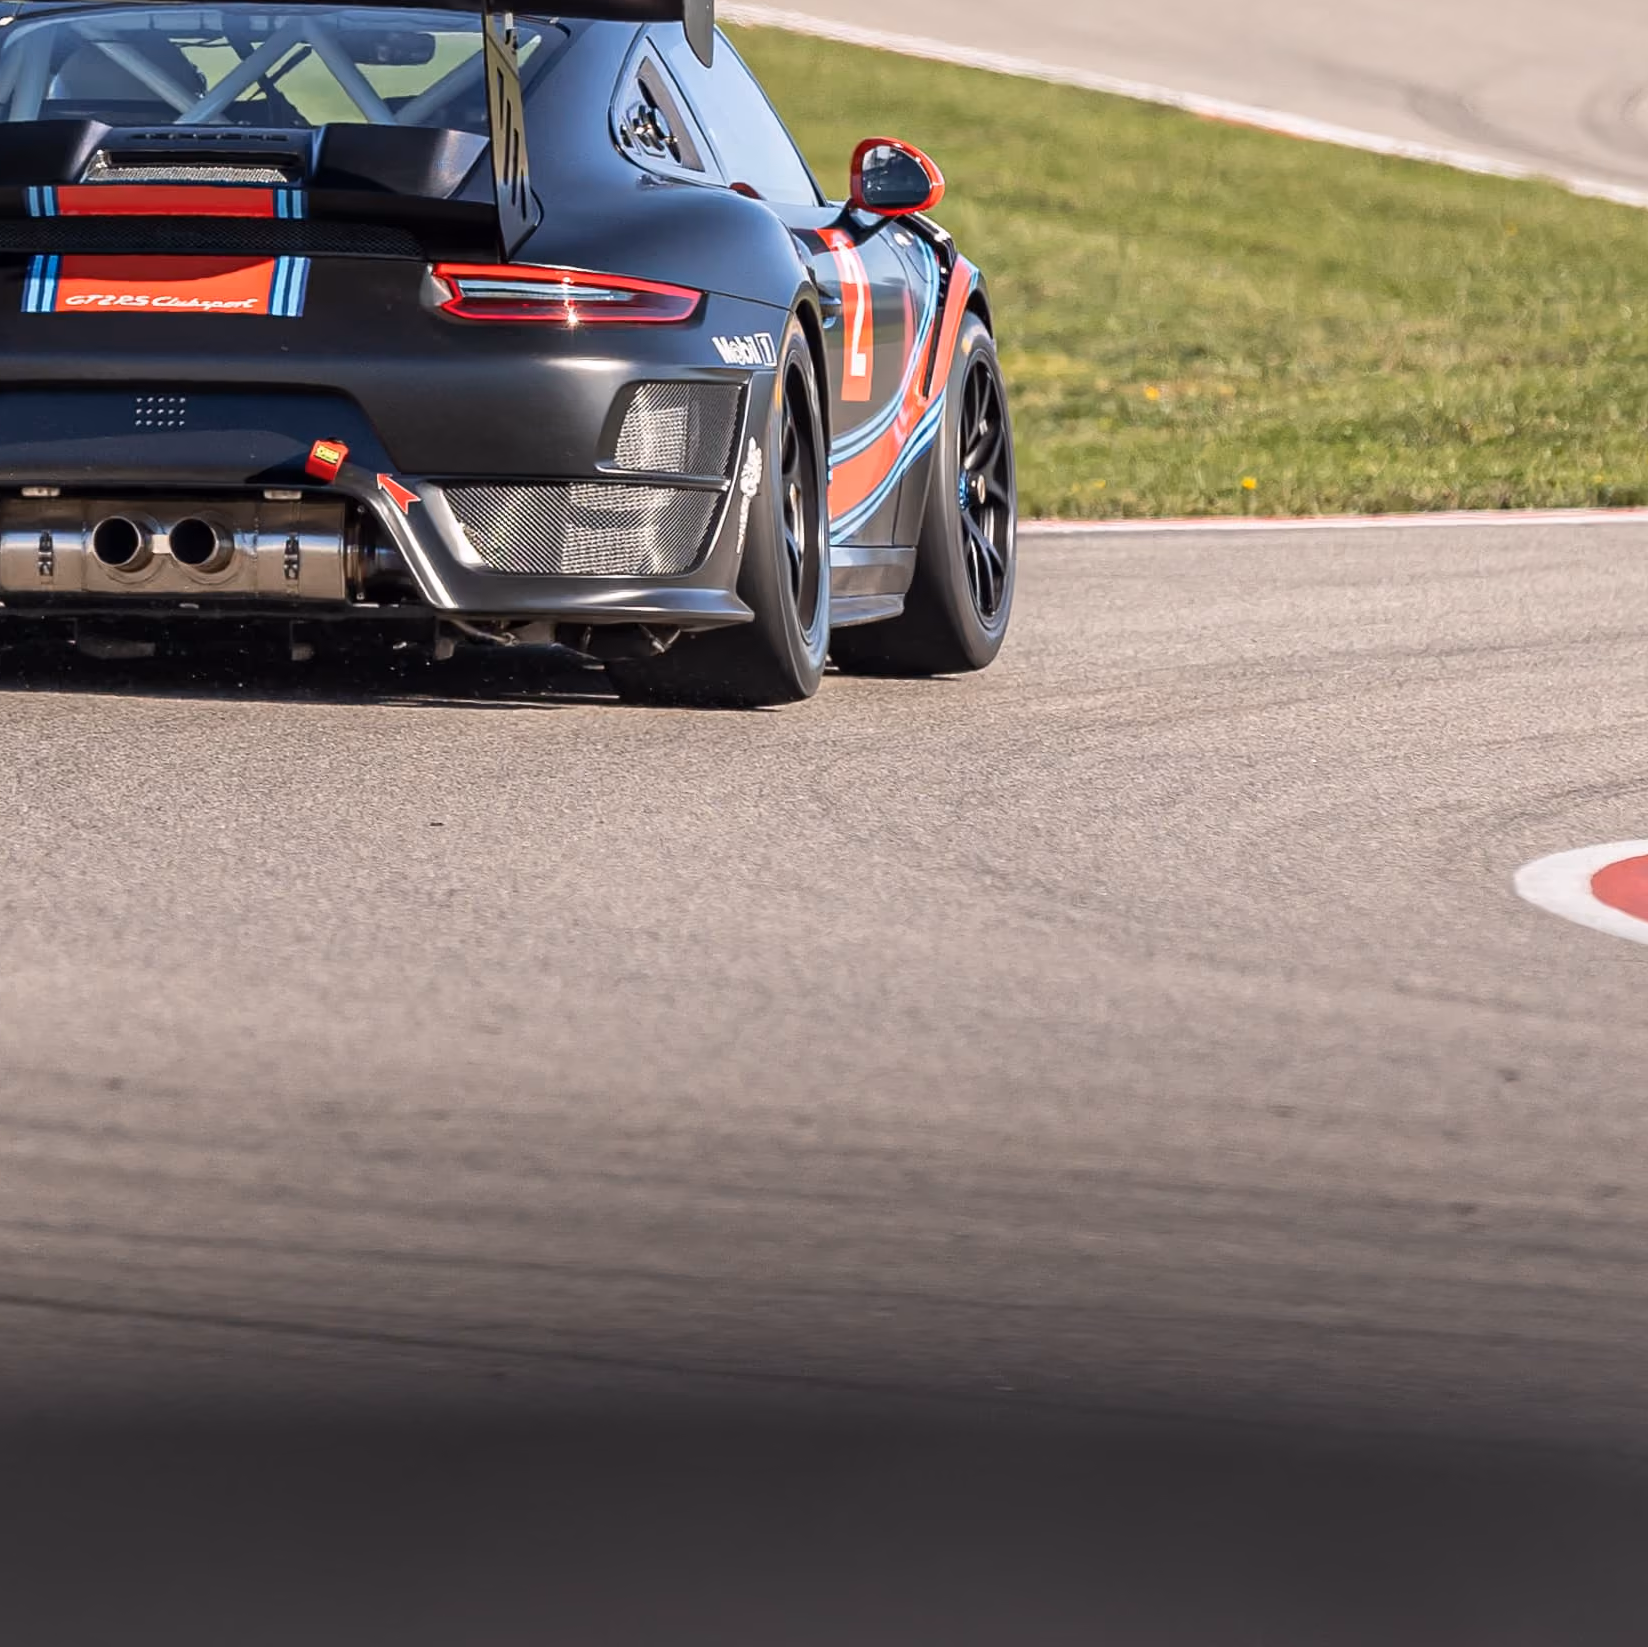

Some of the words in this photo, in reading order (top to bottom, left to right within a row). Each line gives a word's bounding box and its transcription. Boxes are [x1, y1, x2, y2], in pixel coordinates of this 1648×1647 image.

[152, 296, 258, 311] Clubsport
[836, 238, 867, 377] 2
[711, 335, 762, 365] Mobil
